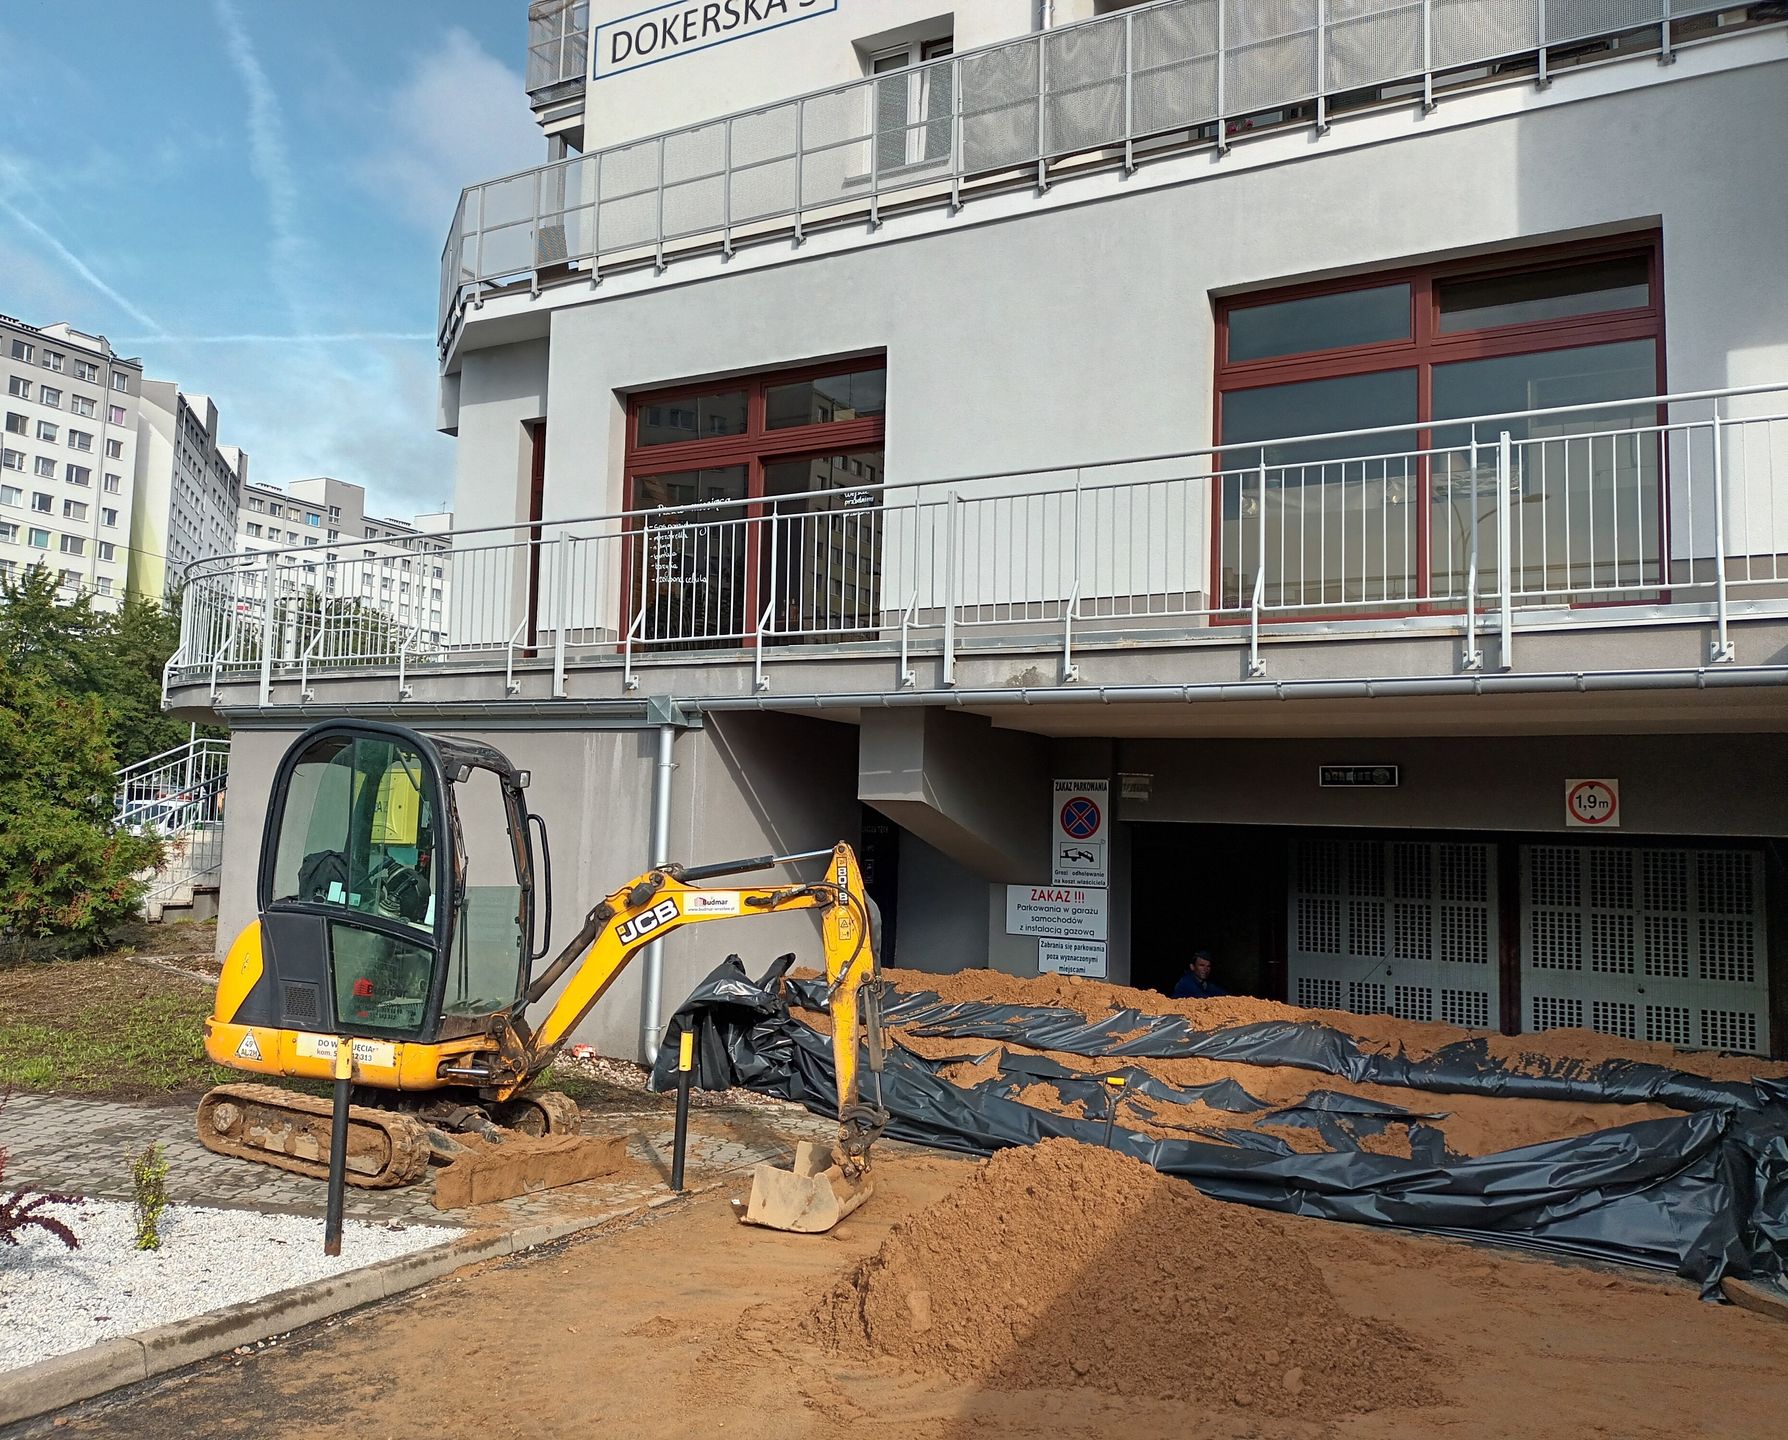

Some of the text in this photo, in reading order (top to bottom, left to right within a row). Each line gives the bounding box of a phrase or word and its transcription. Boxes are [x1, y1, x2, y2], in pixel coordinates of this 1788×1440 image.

[611, 0, 788, 64] DOKERSKA
[1055, 782, 1107, 792] ZAKAZ PARKOWANIA
[1031, 889, 1085, 904] ZAKAZ !!!
[702, 898, 728, 906] Budmar
[1016, 903, 1061, 913] Parkowania
[619, 900, 678, 943] JCB
[1031, 915, 1084, 925] samochodów
[1025, 924, 1062, 935] instalacją
[1063, 928, 1095, 937] gazową
[1040, 941, 1105, 953] Zabrania się parkowania
[1059, 955, 1098, 965] wyznaczonymi
[1058, 965, 1086, 974] miejscami
[318, 1039, 330, 1047] DO
